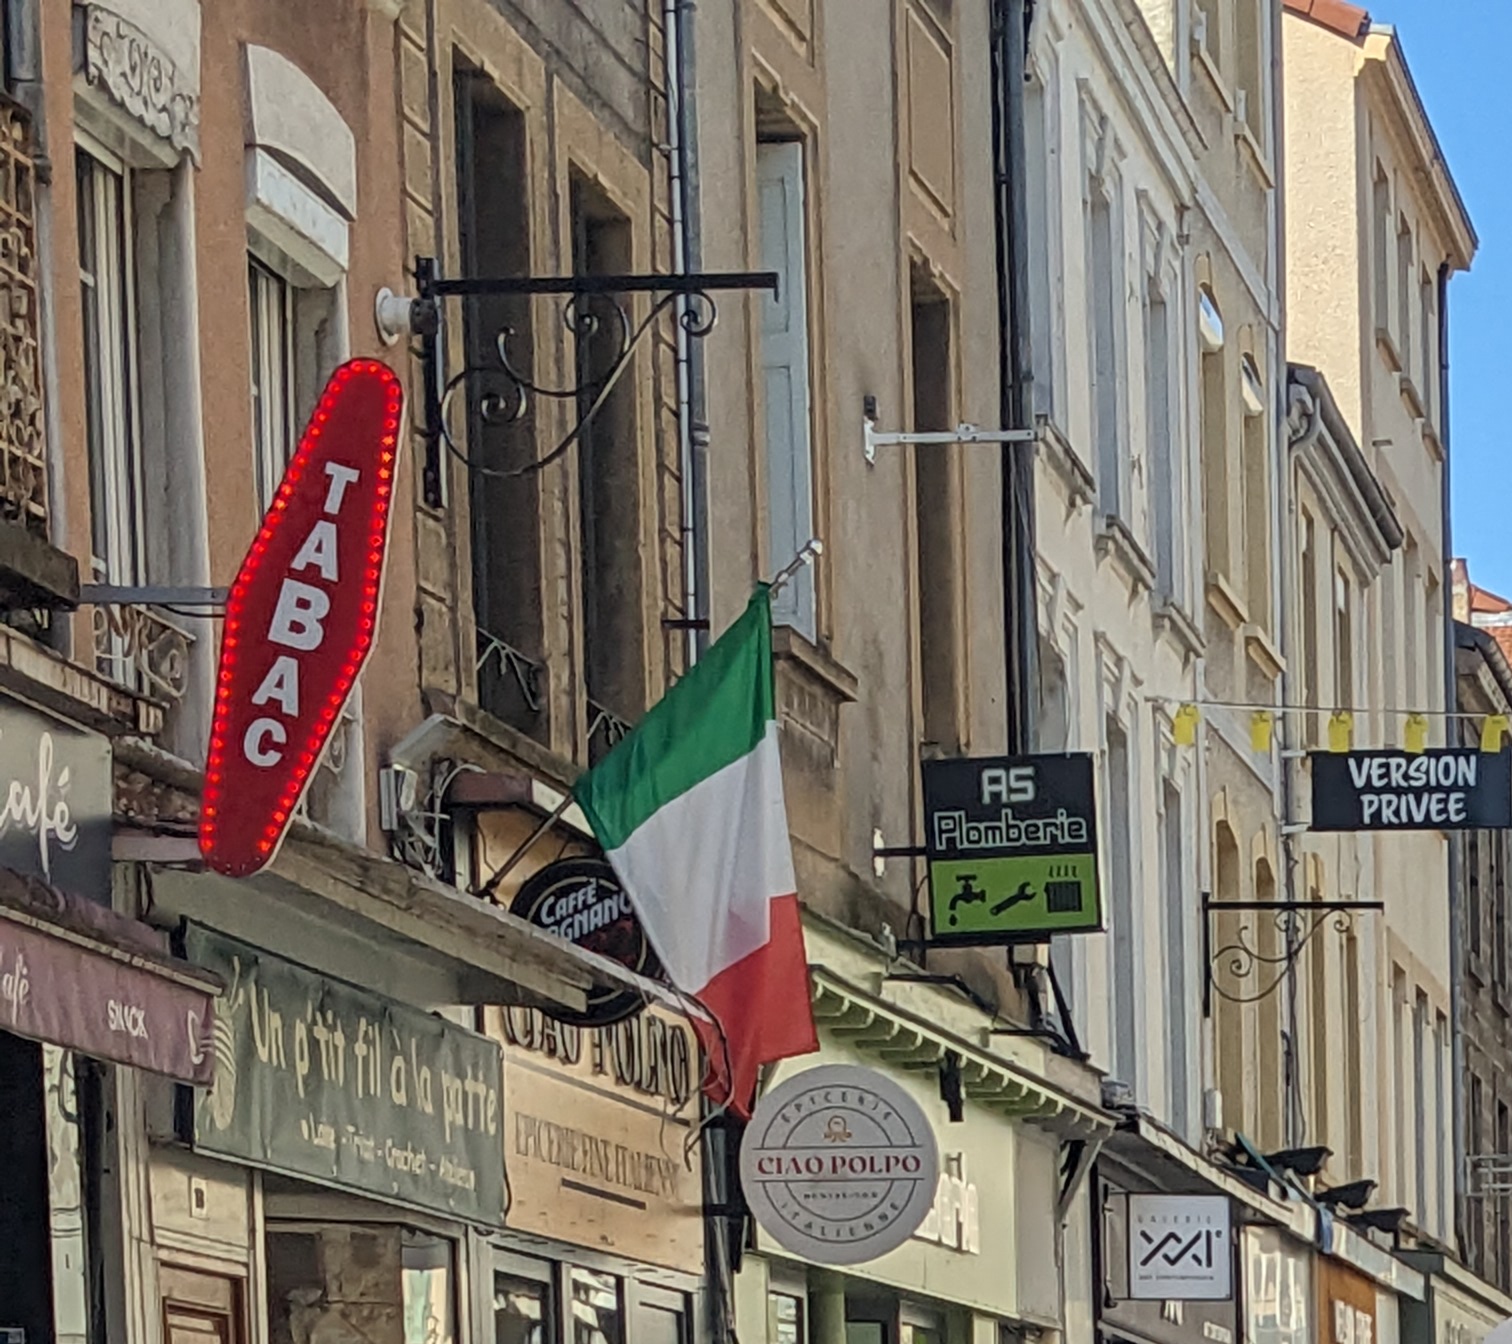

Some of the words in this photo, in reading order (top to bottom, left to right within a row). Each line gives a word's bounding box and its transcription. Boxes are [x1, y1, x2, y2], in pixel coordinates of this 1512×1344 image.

[243, 462, 360, 767] TABAC
[981, 766, 1036, 804] AS
[1347, 754, 1477, 789] VERSION
[0, 731, 77, 884] afé
[1360, 792, 1467, 824] PRIVEE
[933, 808, 1087, 850] Plomberie
[0, 950, 30, 1028] afé
[250, 981, 286, 1069] Un
[295, 1000, 345, 1098] p'tit
[354, 1017, 382, 1098] fil
[391, 1027, 407, 1107] à
[412, 1038, 433, 1113] la
[441, 1066, 497, 1143] patte
[757, 1155, 823, 1176] CIAO
[831, 1154, 921, 1175] POLPO
